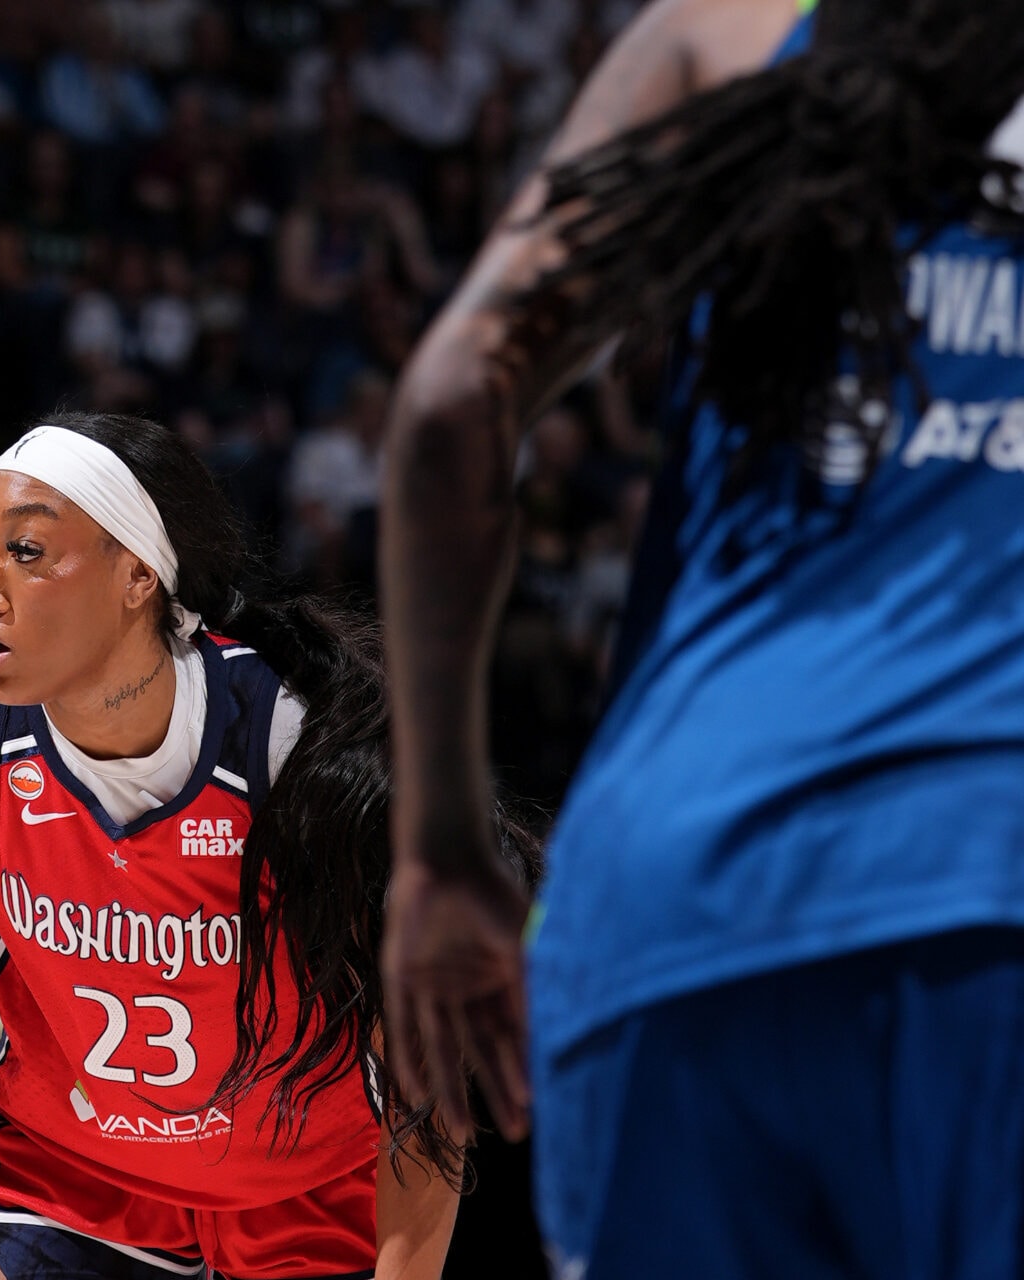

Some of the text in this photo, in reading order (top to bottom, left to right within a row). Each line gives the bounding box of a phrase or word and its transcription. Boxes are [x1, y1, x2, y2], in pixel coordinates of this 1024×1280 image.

[179, 818, 233, 838] CAR
[181, 837, 245, 857] max
[72, 984, 198, 1087] 23
[95, 1106, 233, 1137] VANDA
[101, 1130, 213, 1144] PHARMACEUTICALS
